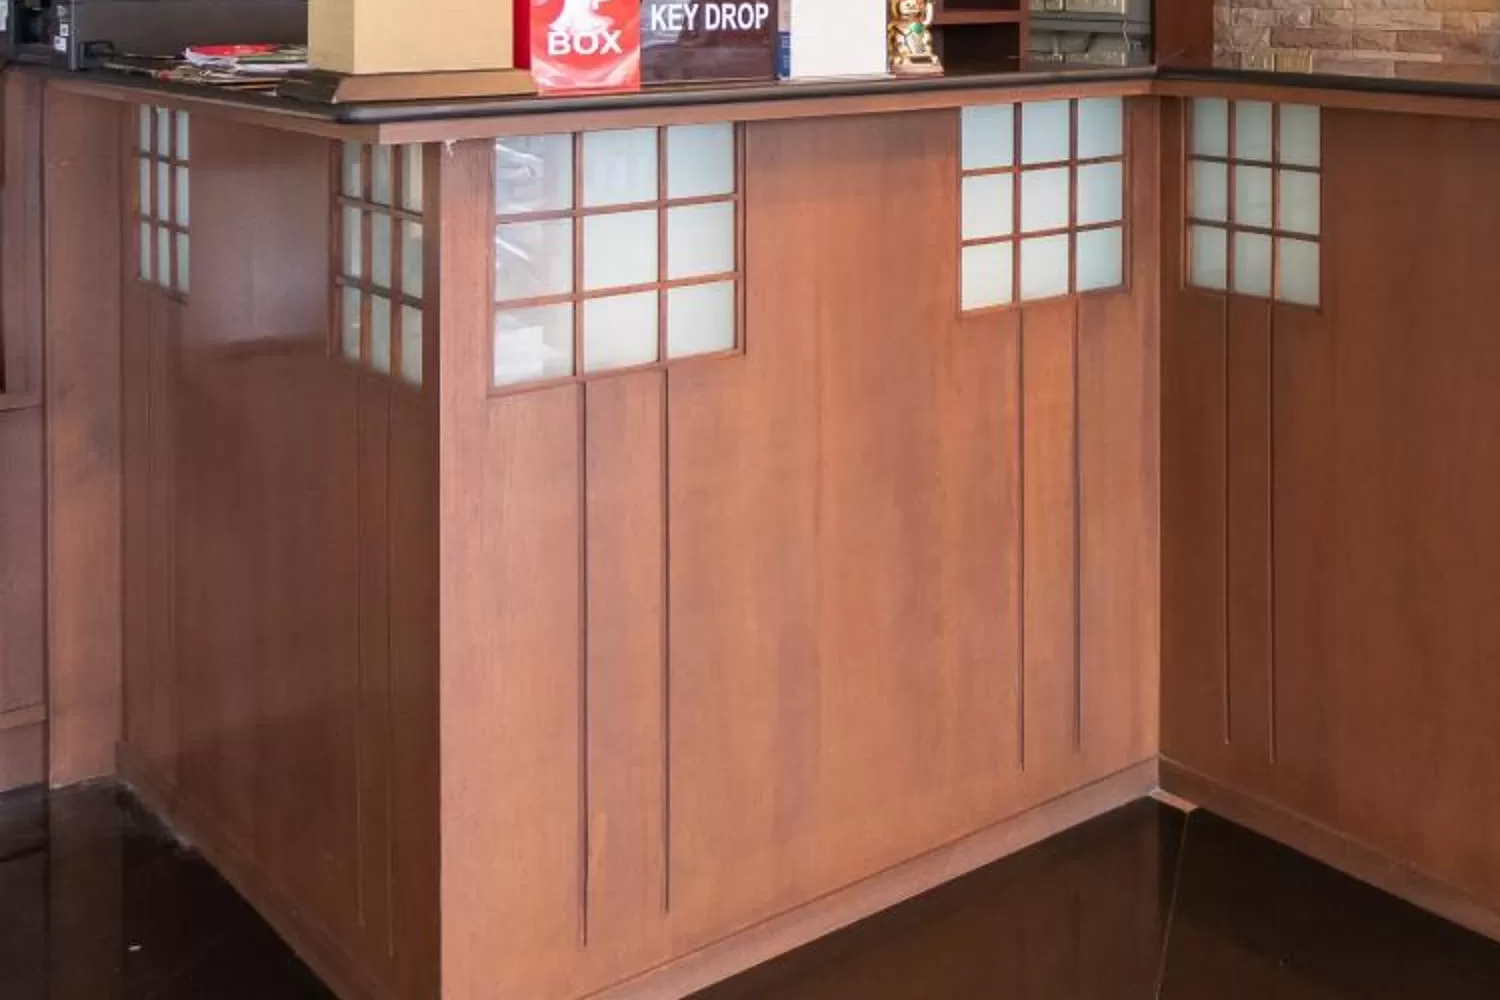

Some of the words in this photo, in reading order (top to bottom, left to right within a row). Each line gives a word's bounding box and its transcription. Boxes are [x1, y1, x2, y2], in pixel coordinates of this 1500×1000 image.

[651, 3, 699, 31] KEY
[705, 2, 769, 30] DROP
[547, 30, 622, 55] BOX
